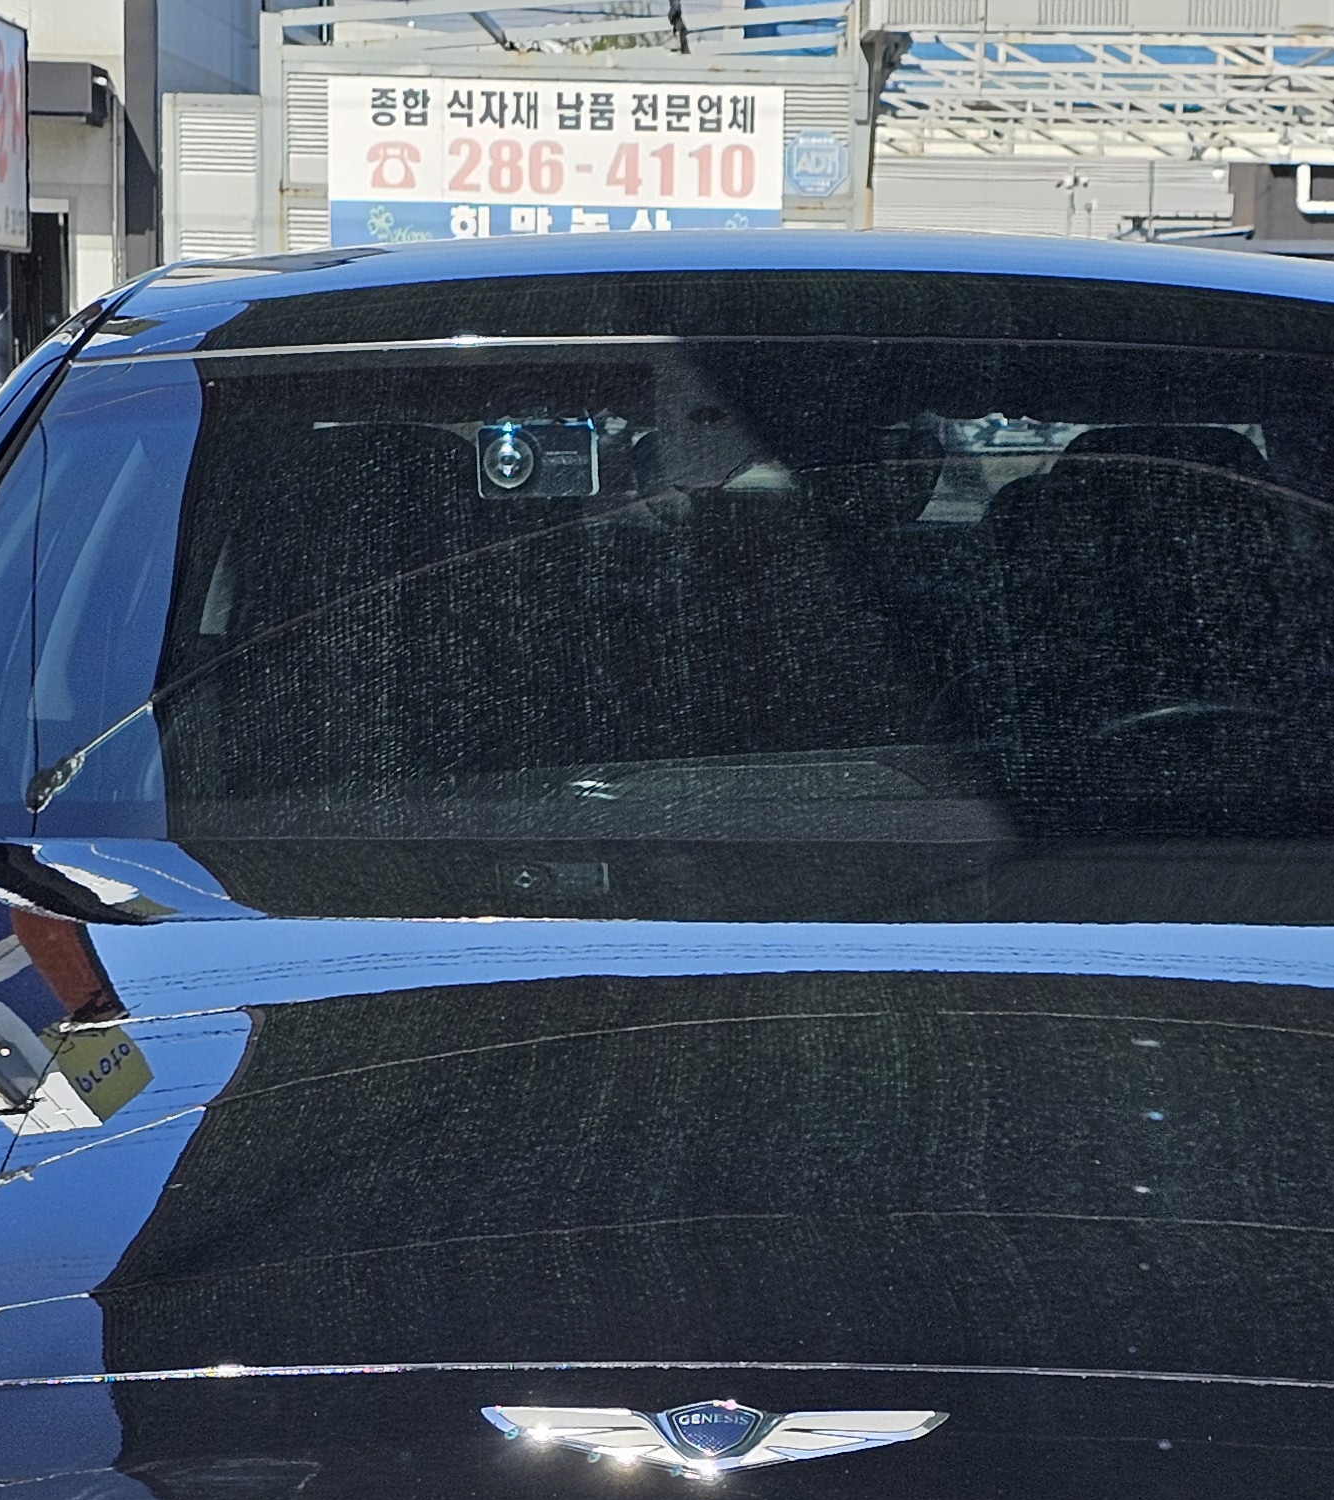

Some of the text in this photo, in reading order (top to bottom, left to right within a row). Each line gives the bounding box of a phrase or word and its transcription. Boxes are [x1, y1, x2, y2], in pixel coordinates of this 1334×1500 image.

[370, 87, 756, 134] 종합 식자재 납품 전문업체
[448, 137, 757, 199] 286-4110
[796, 150, 837, 175] ADT
[678, 1413, 750, 1426] GENESIS
